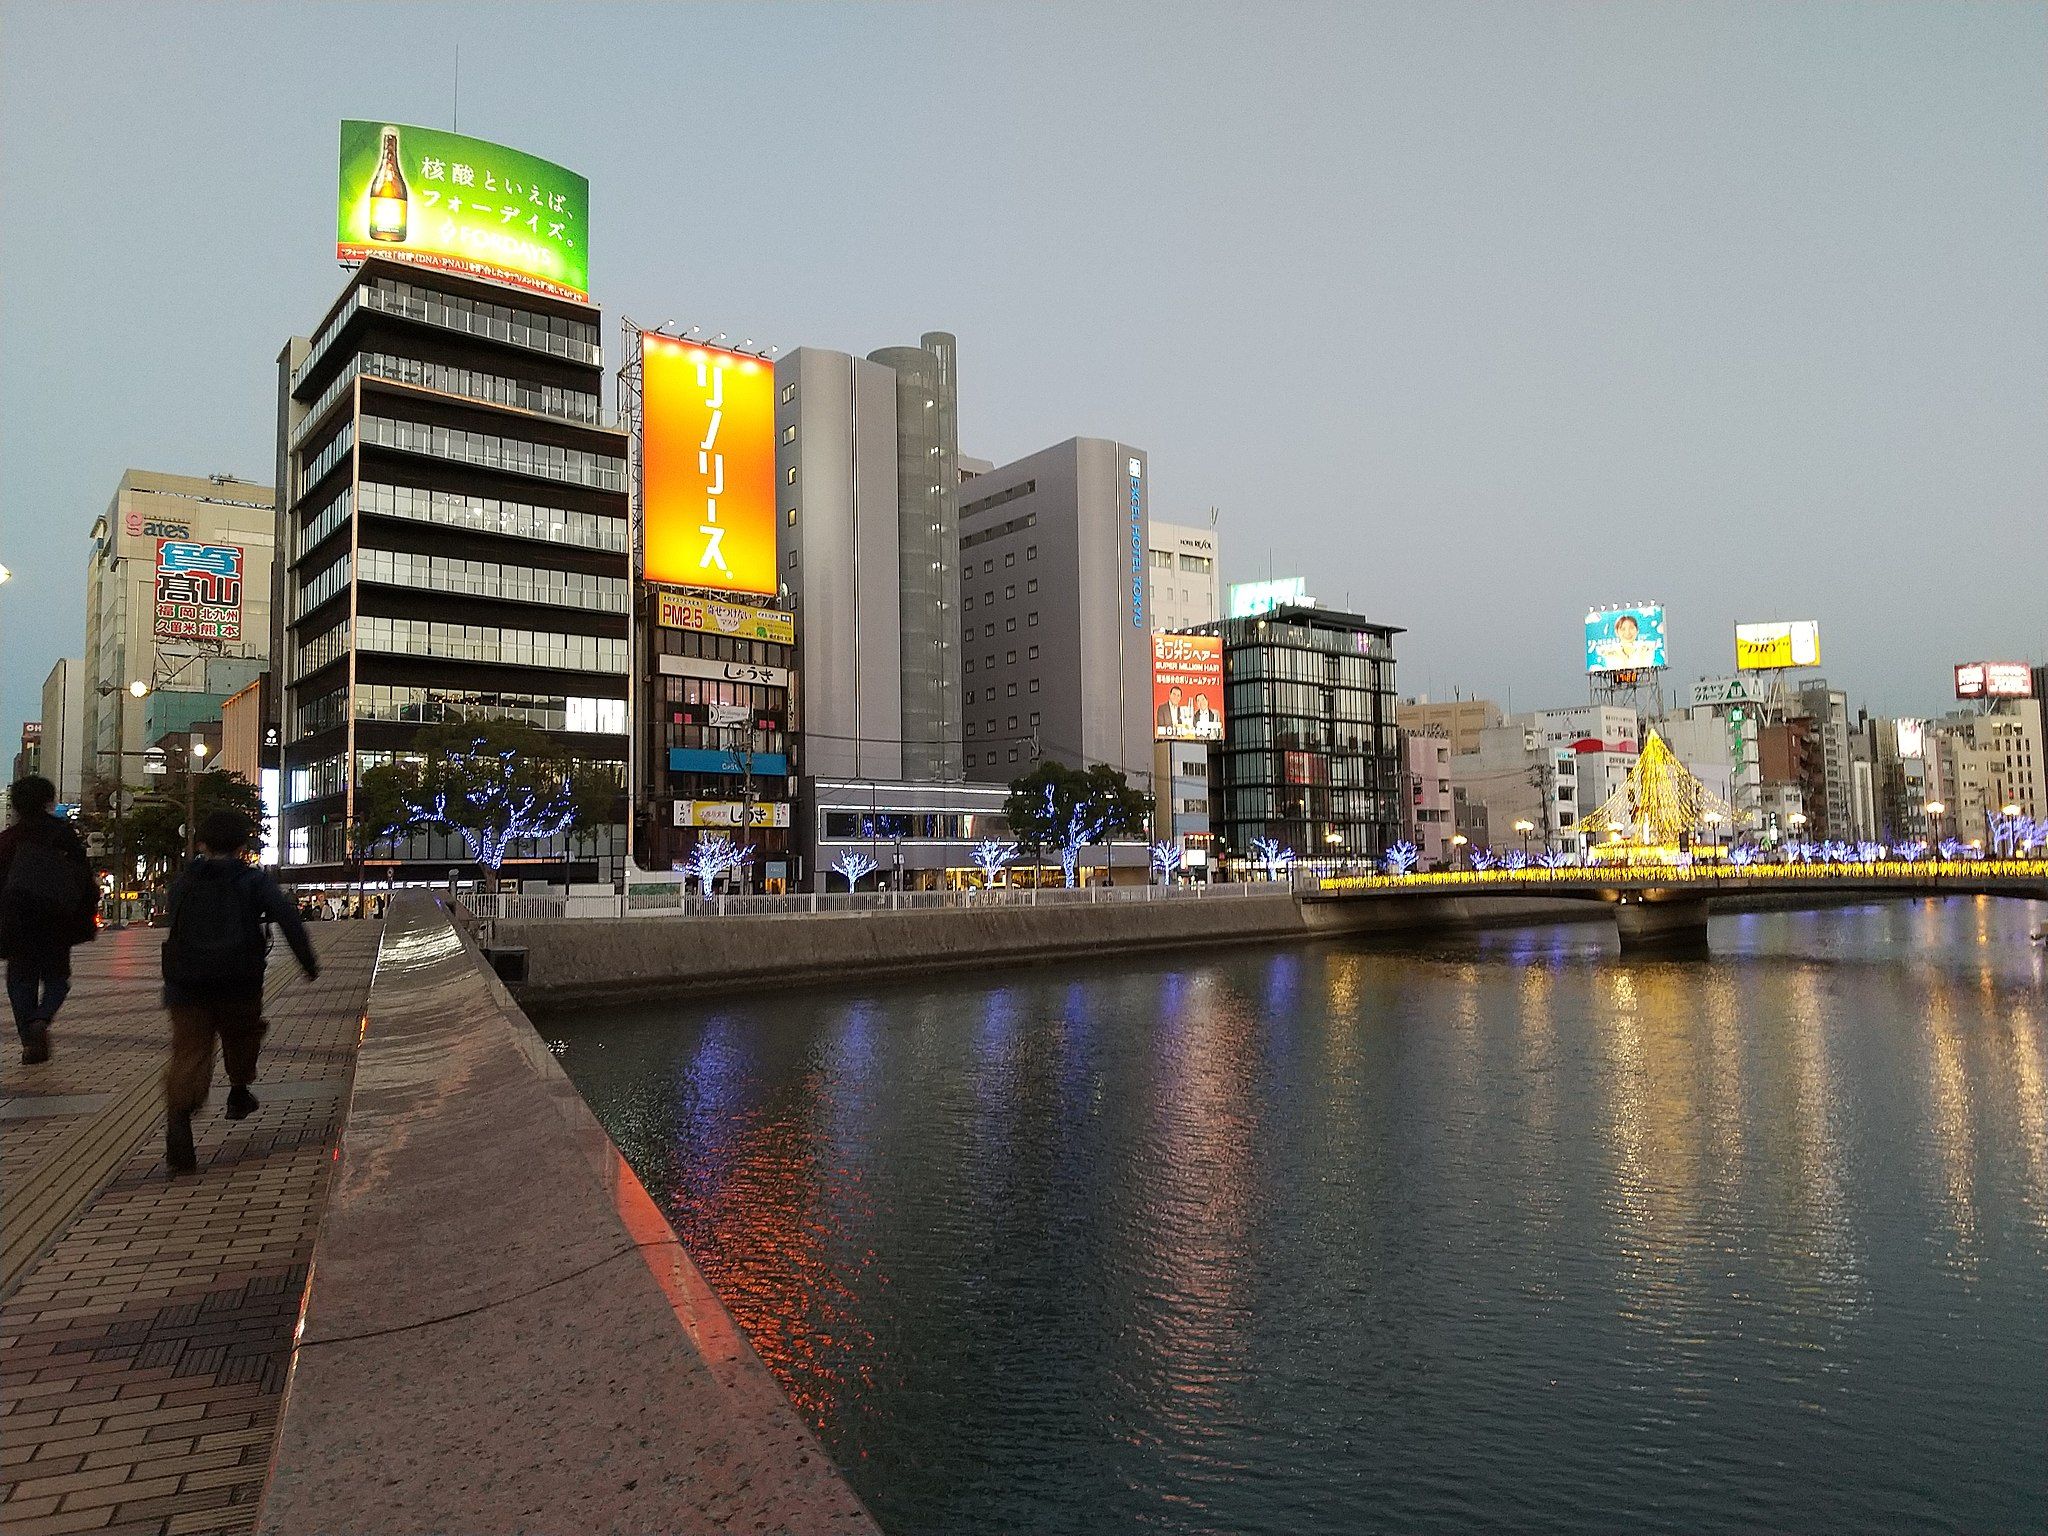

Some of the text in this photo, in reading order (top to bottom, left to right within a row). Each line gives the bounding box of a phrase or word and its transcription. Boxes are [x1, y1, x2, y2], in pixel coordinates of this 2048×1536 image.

[420, 155, 574, 221] 核酸といえば、
[421, 189, 575, 249] フォーデイズ。
[1129, 477, 1143, 629] EXCEL HOTEL TOKYU
[157, 604, 239, 624] 福岡 北九州
[662, 603, 704, 629] PM2.5
[156, 619, 239, 637] 久留米 熊本
[1748, 643, 1777, 654] DRY
[1155, 661, 1178, 670] SUPER
[1178, 662, 1203, 672] MILLION
[1694, 685, 1724, 693] ウチヤマ
[1695, 693, 1724, 702] グループ
